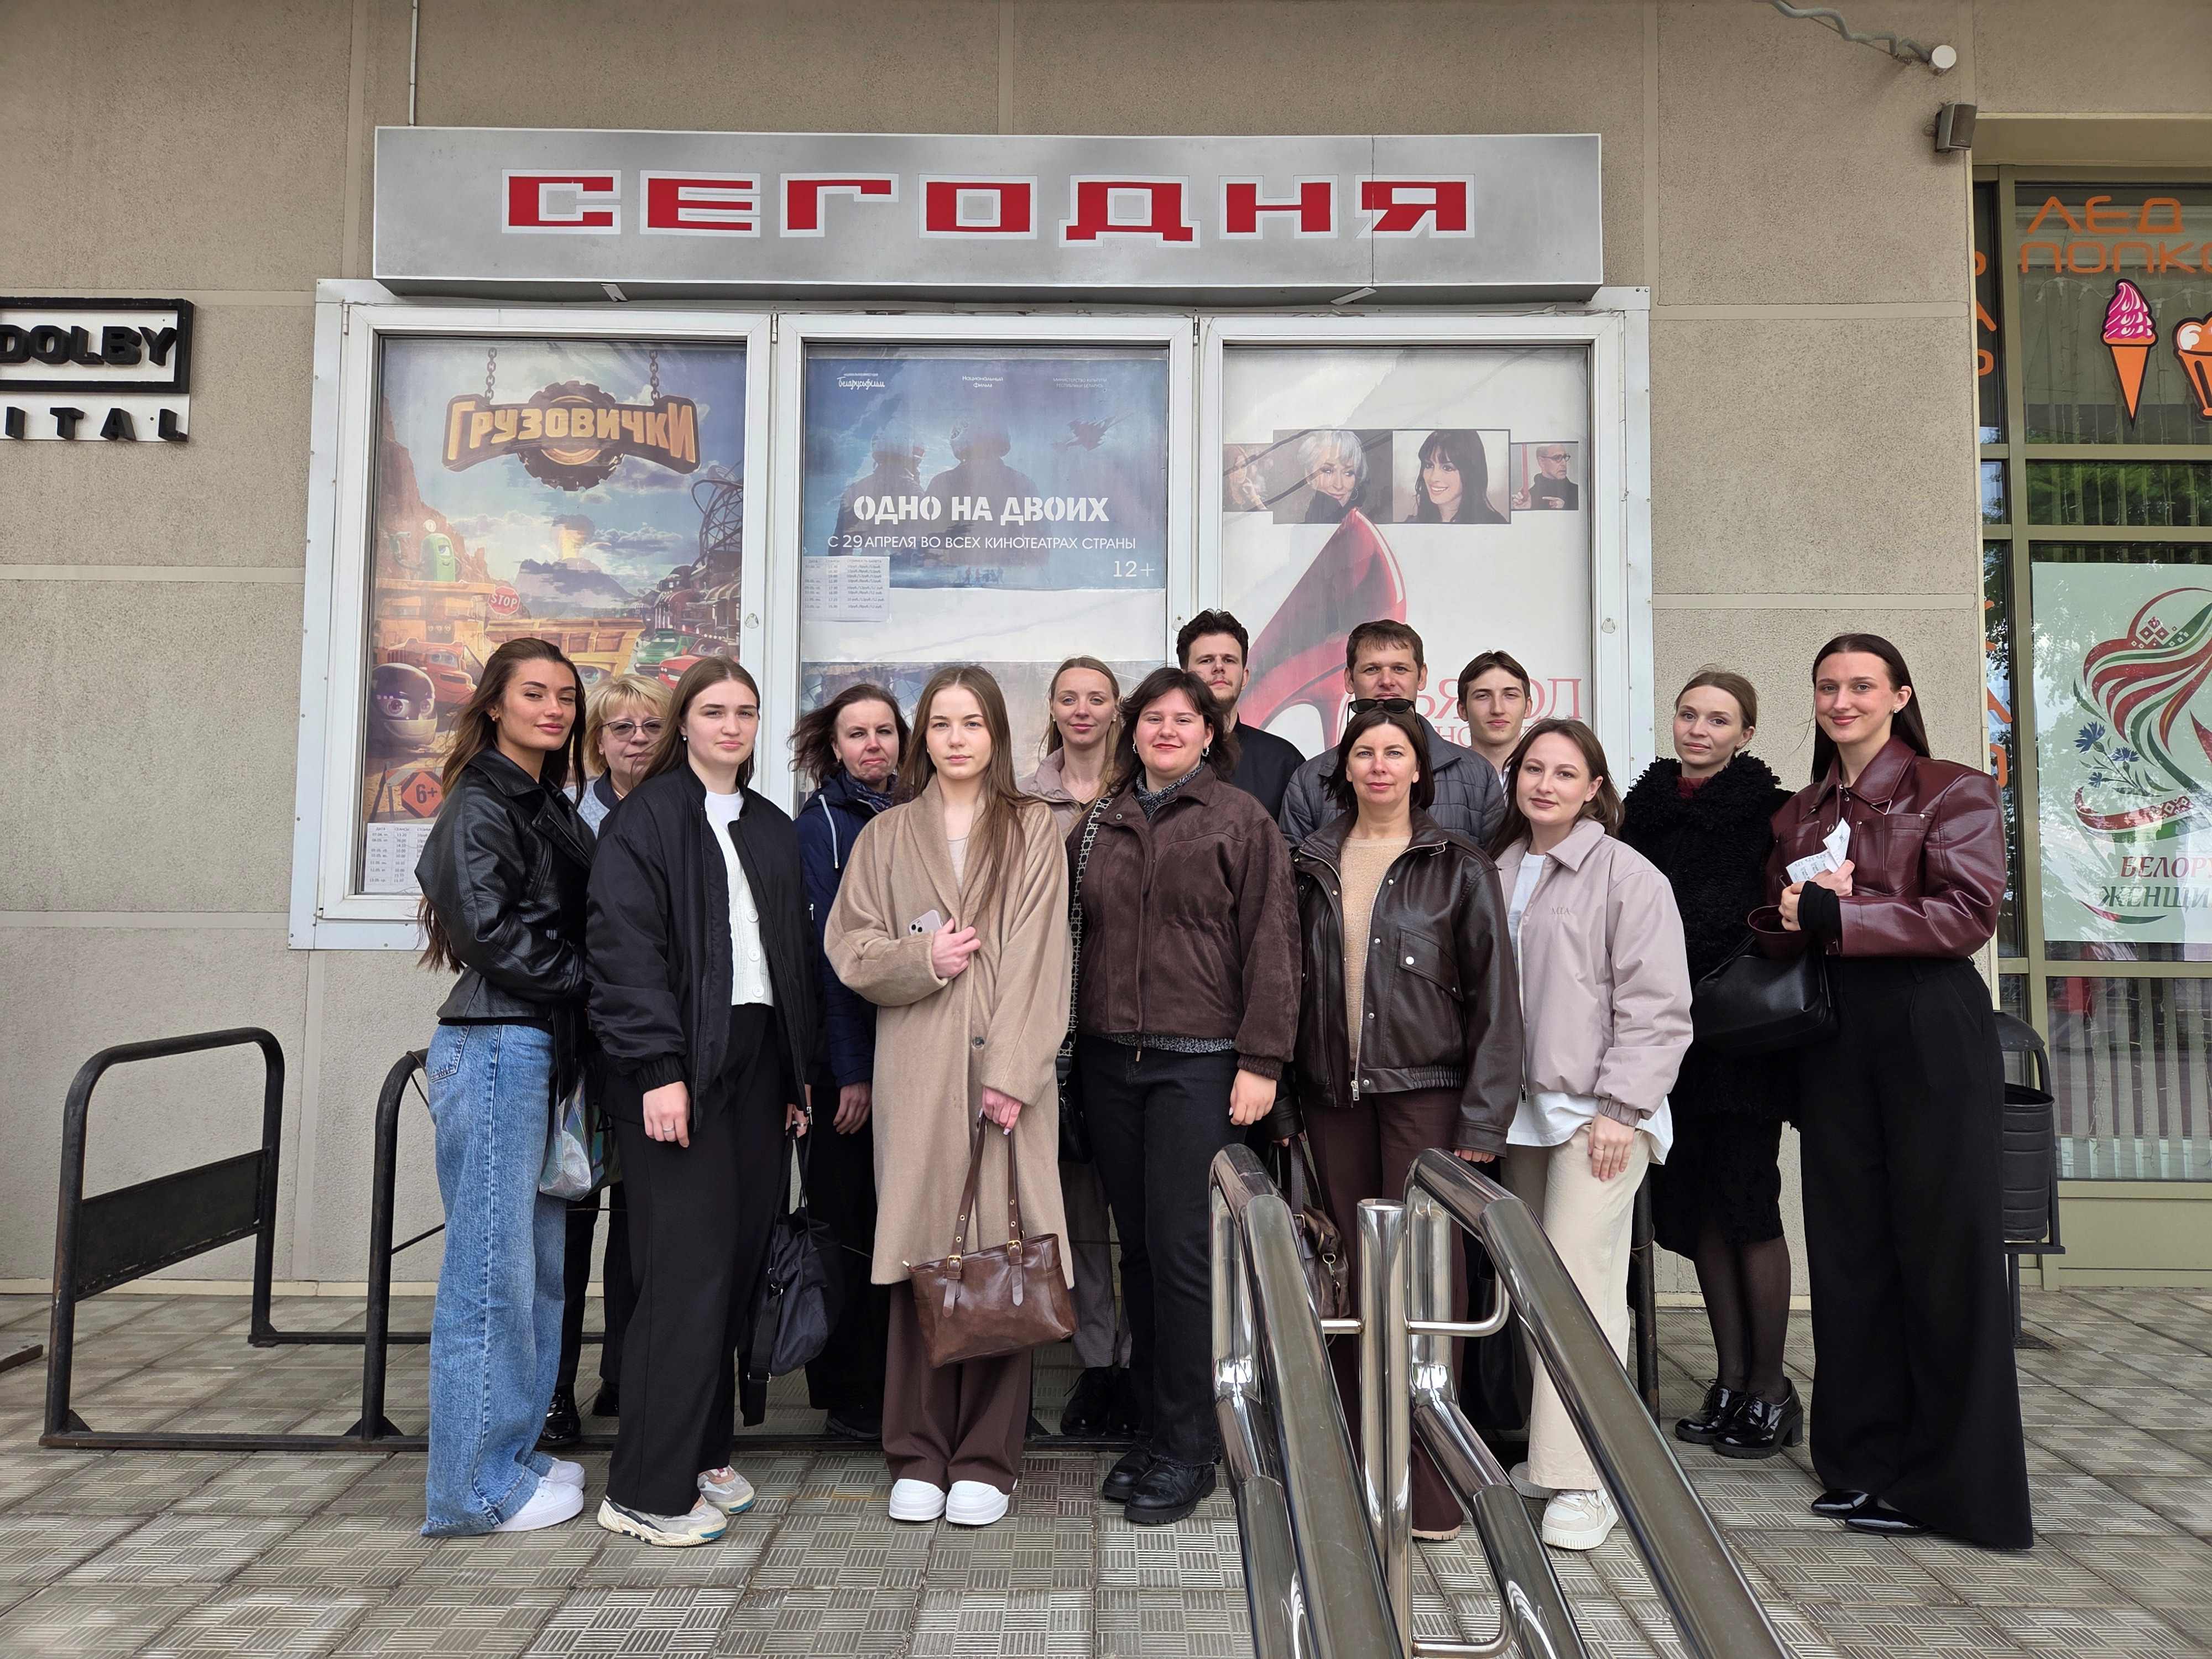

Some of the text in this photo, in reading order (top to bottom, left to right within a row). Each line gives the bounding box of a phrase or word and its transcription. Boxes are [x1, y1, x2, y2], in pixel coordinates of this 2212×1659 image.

[502, 169, 1474, 247] СЕГОДНЯ
[2021, 241, 2212, 273] ПОПК
[0, 324, 178, 366] DOLBY
[853, 495, 1109, 526] ОДНО НА ДВОИХ
[827, 535, 1136, 550] С 29 АПРЕЛЯ ВО ВСЕХ КИНОТЕАТРАХ СТРАНЫ
[1112, 560, 1155, 578] 12+
[491, 593, 518, 608] STOP
[416, 784, 438, 804] 6+
[2098, 886, 2212, 913] ЖЕНЩИ
